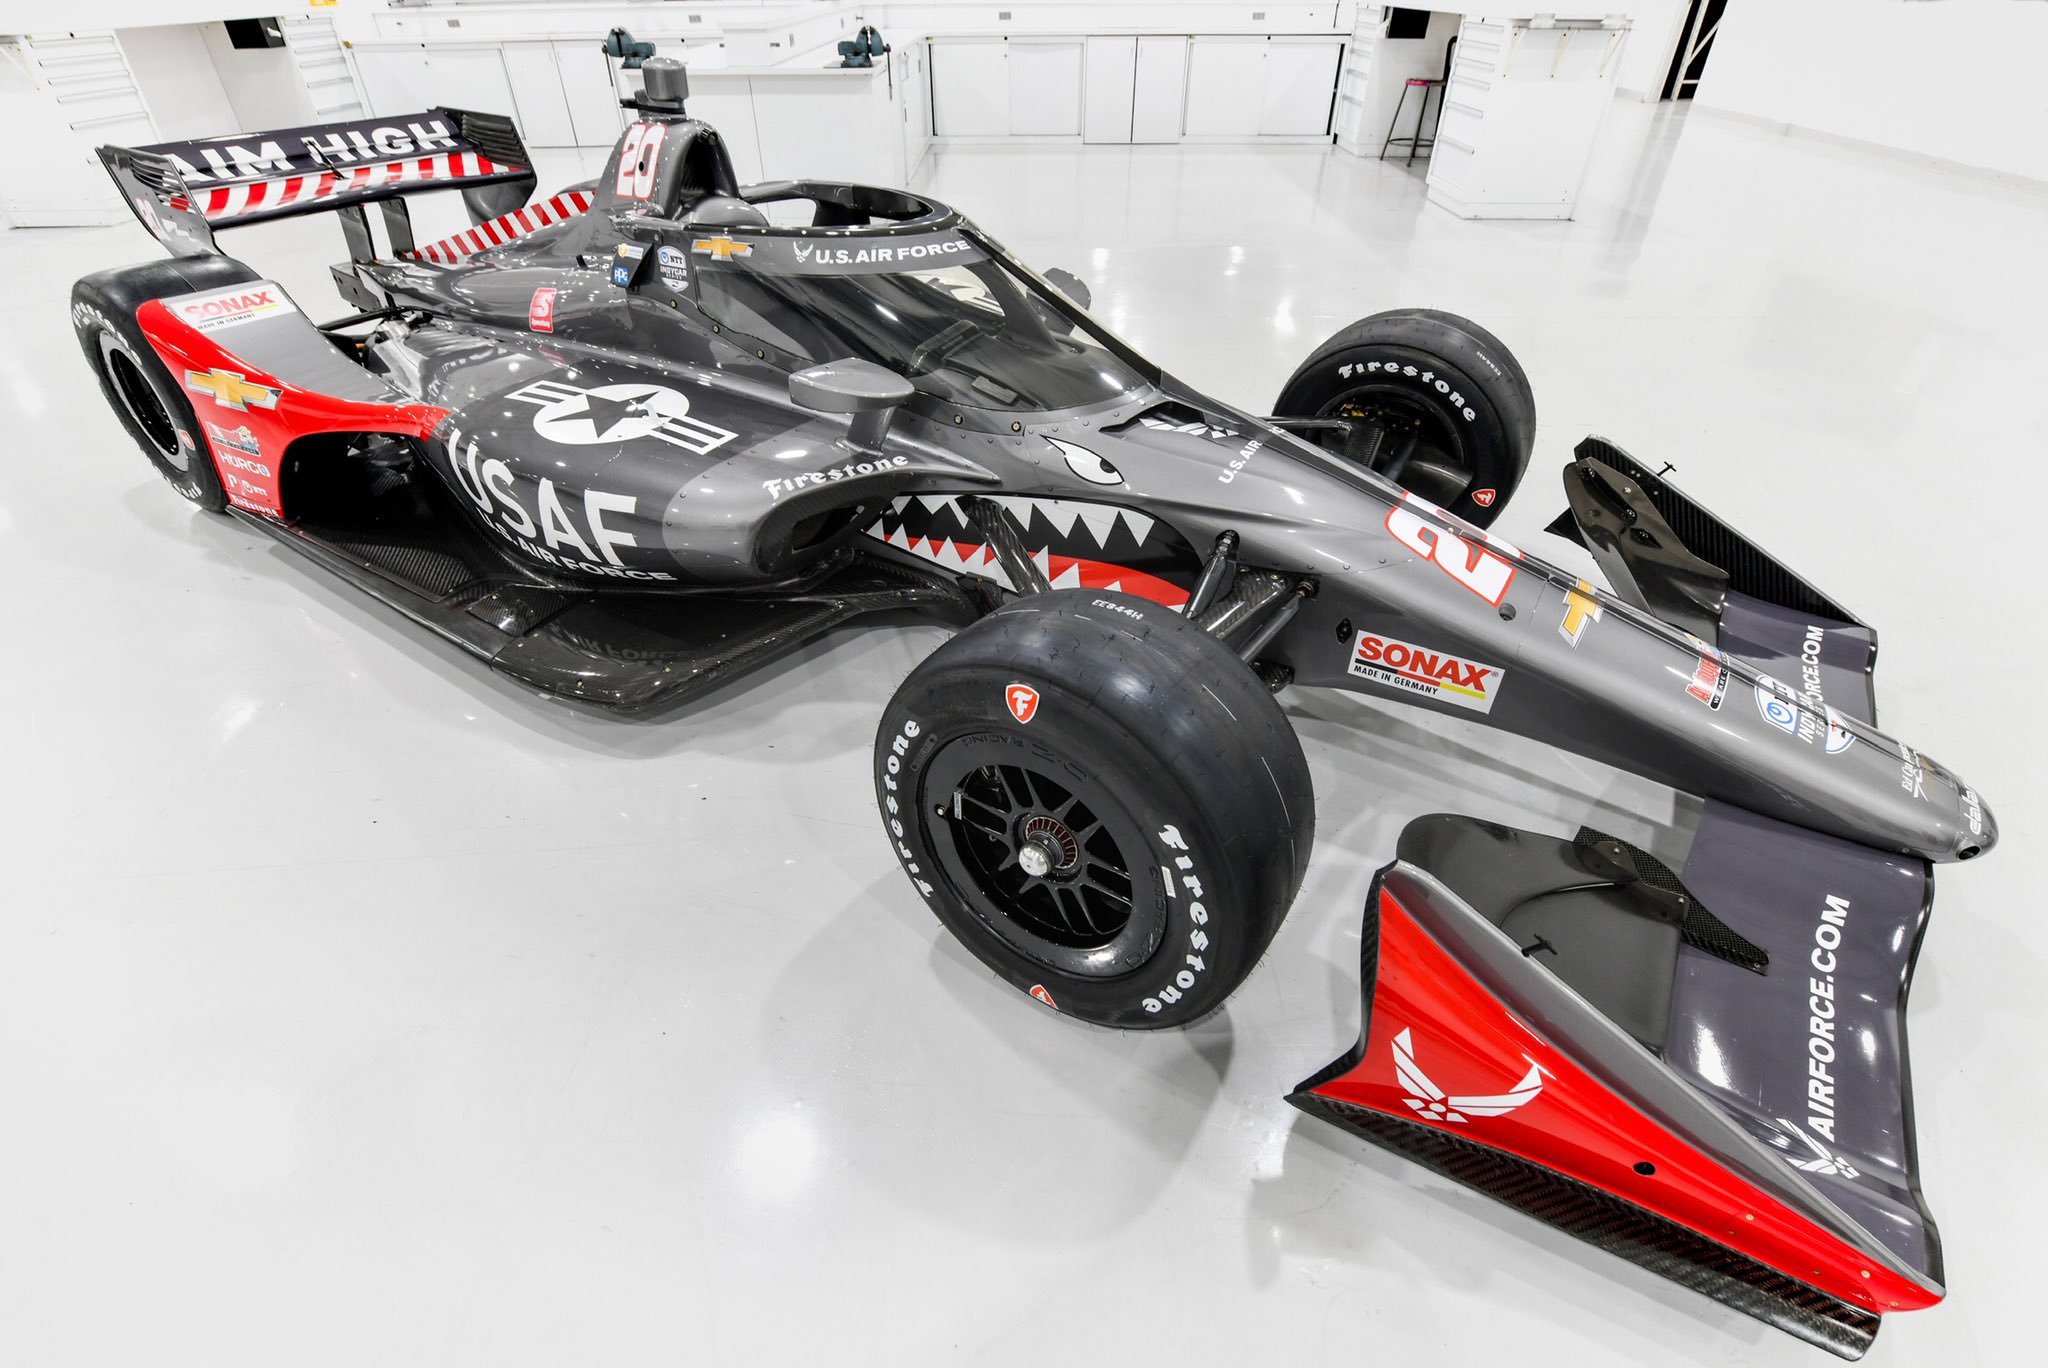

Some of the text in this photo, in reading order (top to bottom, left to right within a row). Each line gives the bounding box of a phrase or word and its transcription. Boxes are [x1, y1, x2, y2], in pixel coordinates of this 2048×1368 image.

[165, 120, 459, 182] AIM HIGH
[616, 122, 668, 200] 20
[660, 265, 688, 277] INDYCAR
[670, 255, 683, 265] NTT
[897, 240, 972, 260] FORCE
[614, 268, 628, 282] PPG
[184, 291, 275, 318] SONAX
[1338, 361, 1477, 422] Firestone
[218, 449, 271, 478] HURCO
[763, 455, 909, 500] Firestone
[449, 428, 638, 567] USAF
[562, 559, 678, 581] FORCE
[1353, 665, 1439, 695] MADE IN GERMANY
[1358, 636, 1492, 692] SONAX
[881, 719, 933, 898] Firestone
[1142, 824, 1209, 1014] Firestone
[1808, 894, 1851, 1143] AIRFORCE.COM
